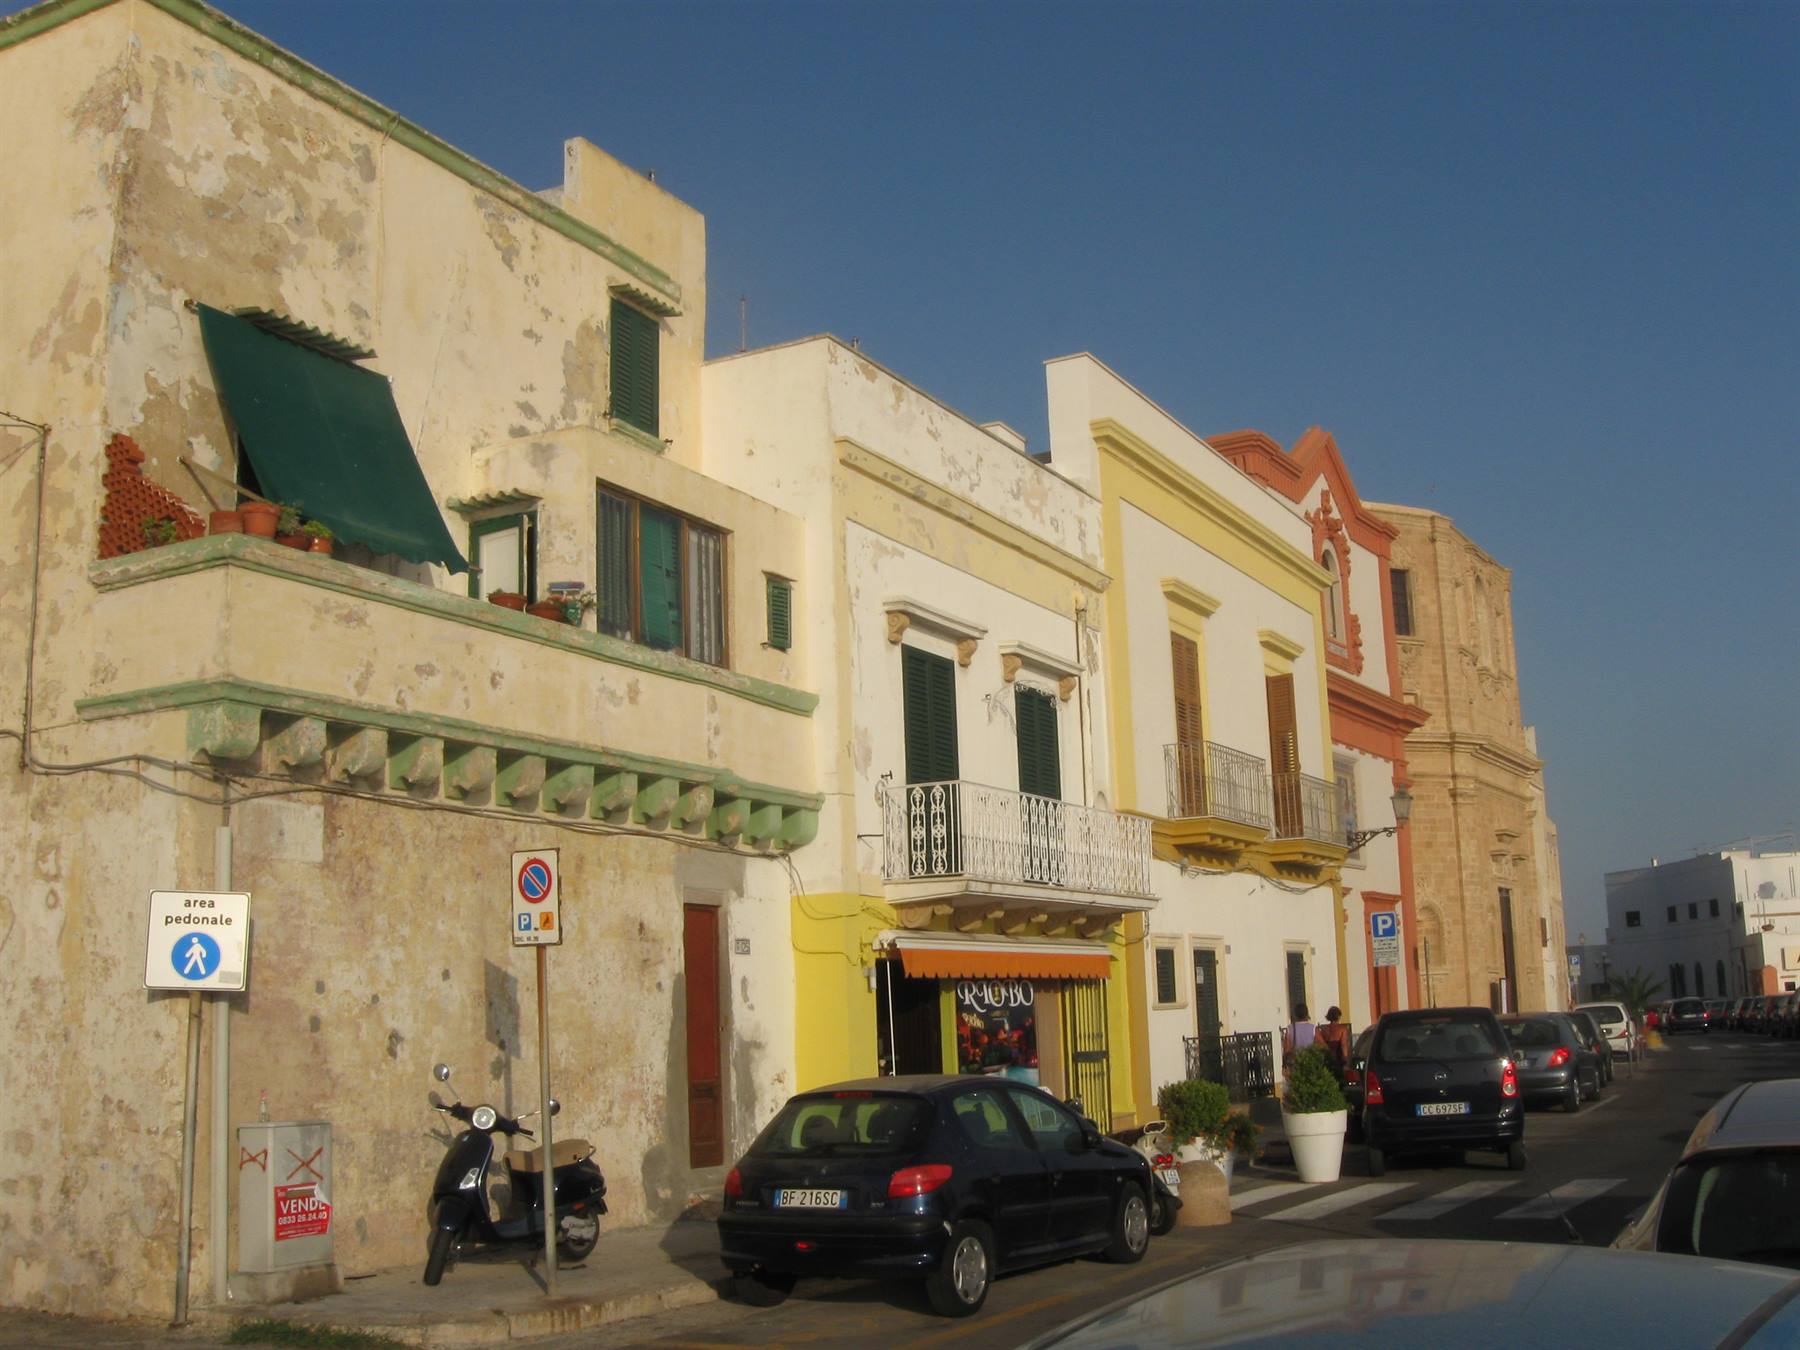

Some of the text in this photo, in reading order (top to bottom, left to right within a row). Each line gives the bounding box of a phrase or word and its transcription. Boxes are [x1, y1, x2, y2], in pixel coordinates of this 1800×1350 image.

[184, 899, 215, 908] area
[164, 913, 233, 926] pedonale
[520, 915, 530, 930] P
[1377, 915, 1393, 936] P
[1422, 1105, 1433, 1115] CC
[781, 1190, 839, 1206] BF 216SC
